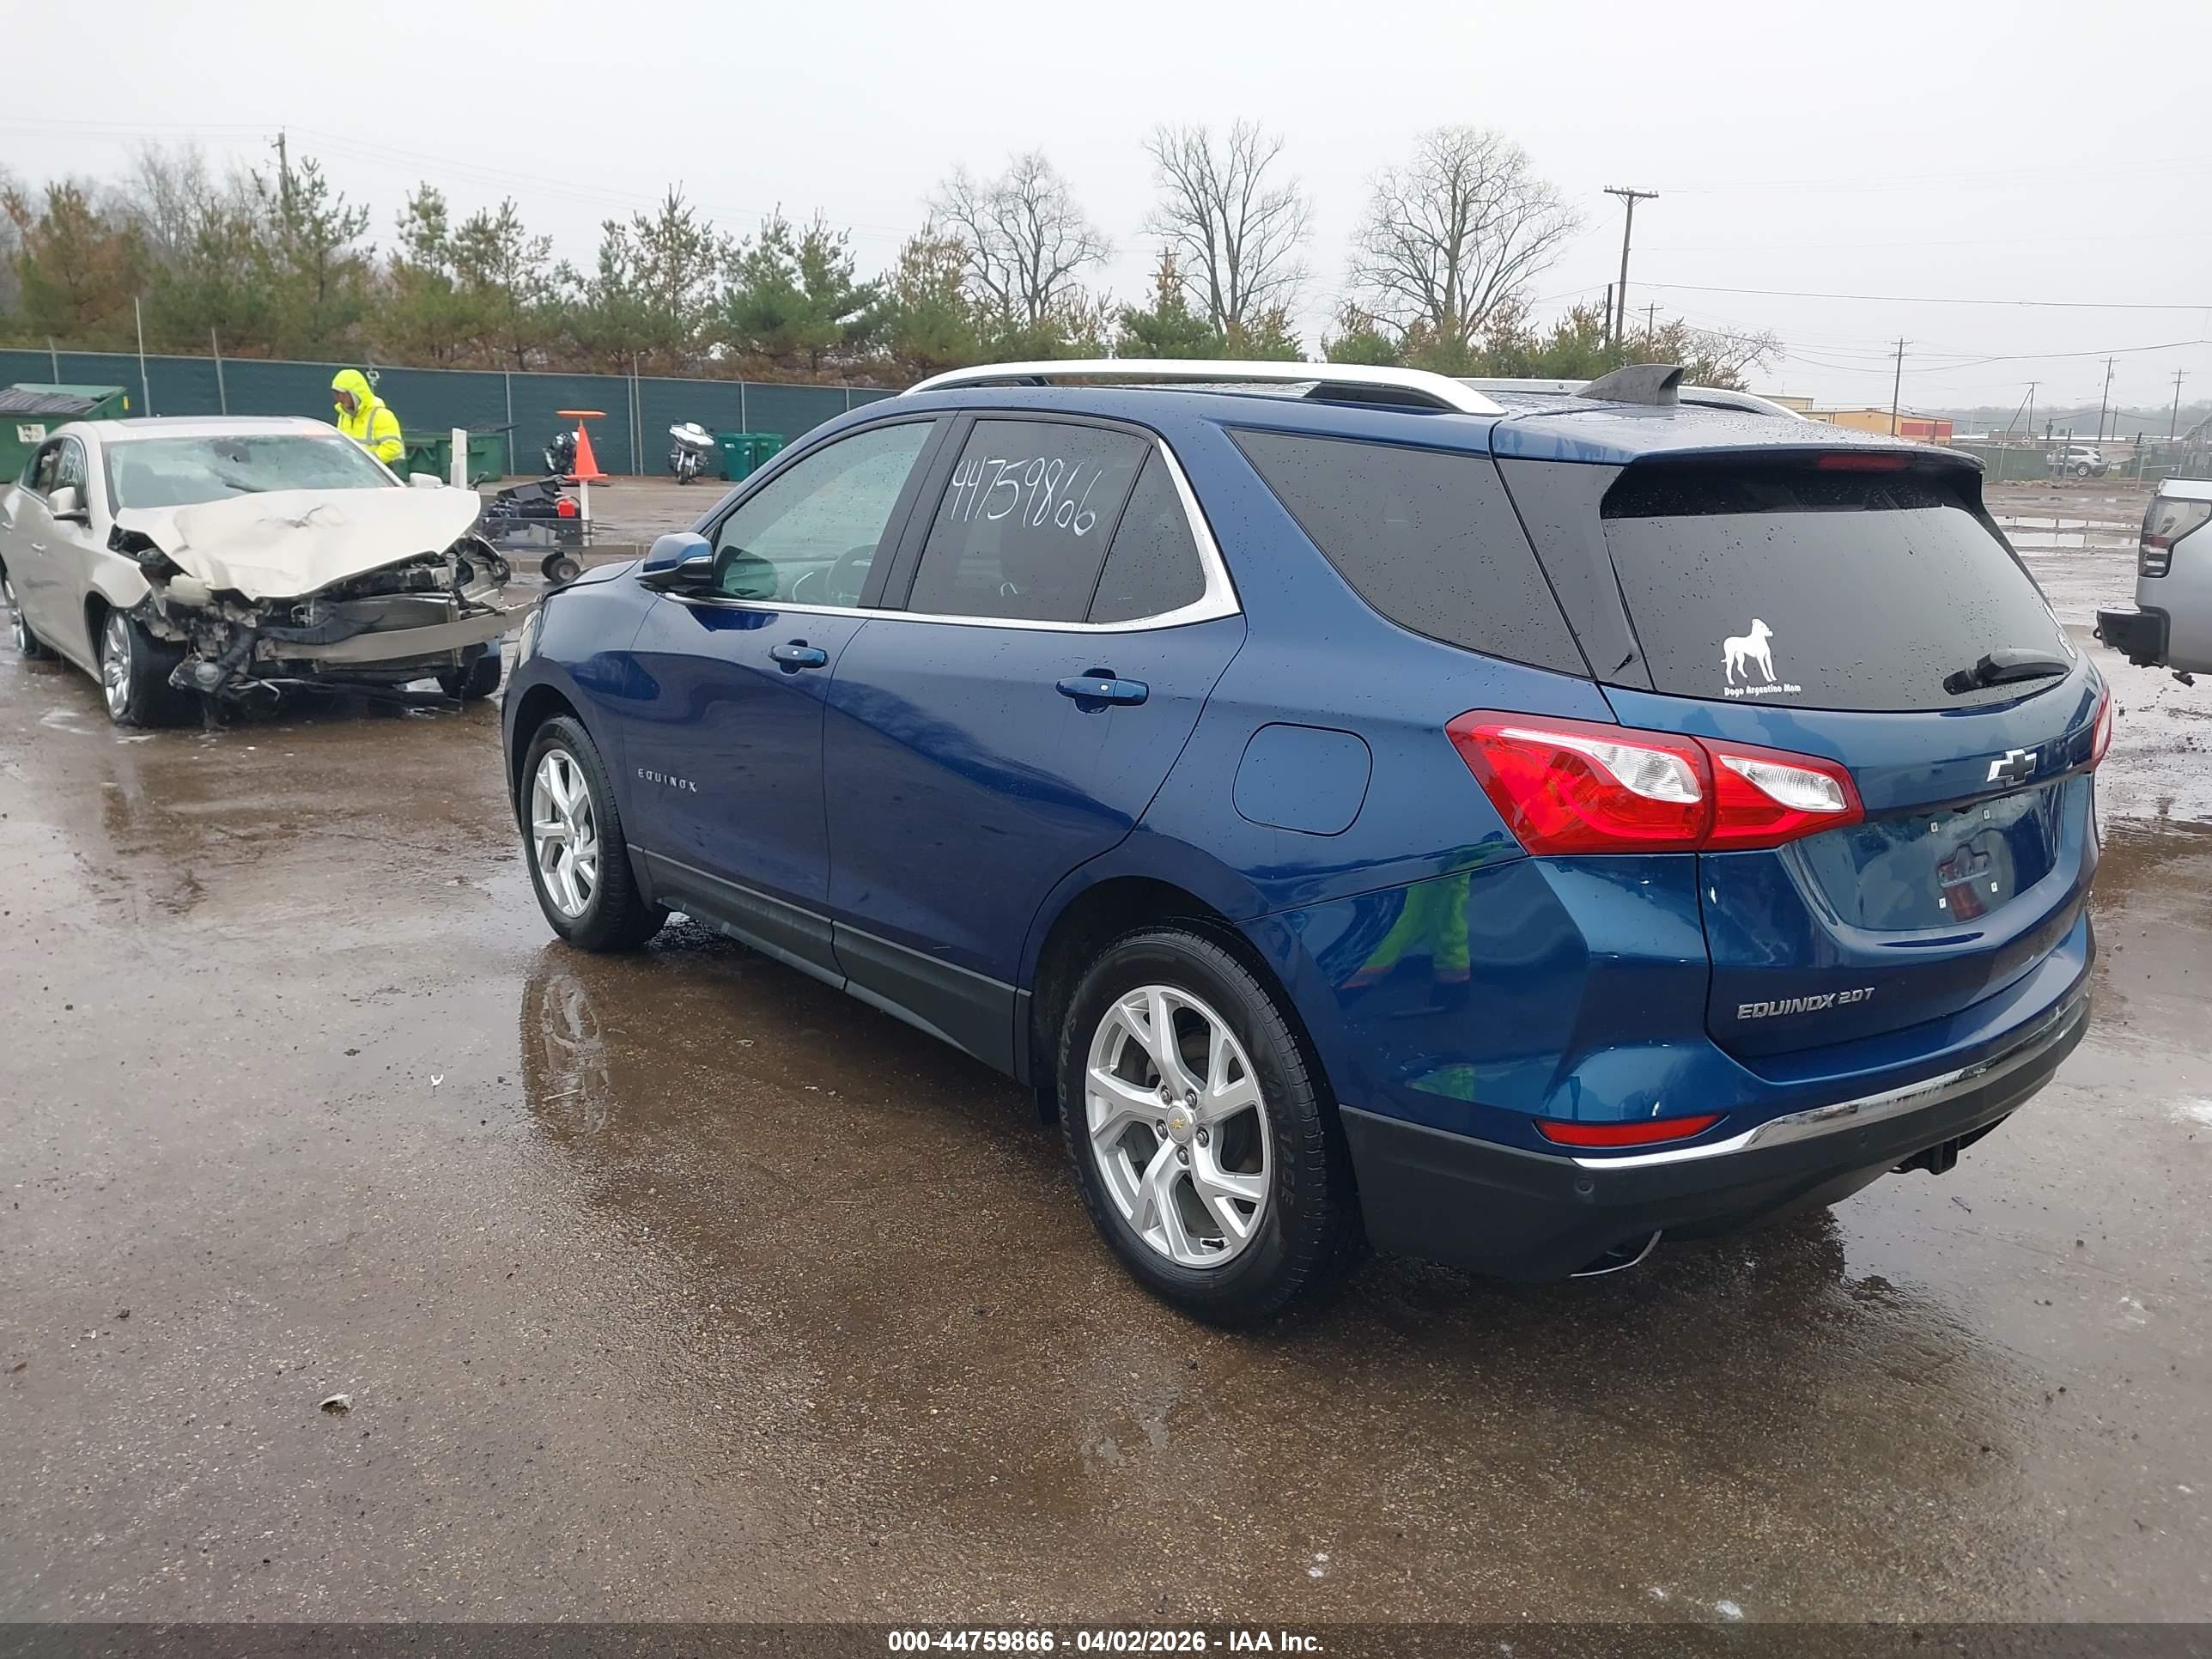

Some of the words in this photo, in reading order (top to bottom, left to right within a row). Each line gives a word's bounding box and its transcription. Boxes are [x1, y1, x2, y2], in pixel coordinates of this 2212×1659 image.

[951, 455, 1103, 537] 44759866
[1723, 687, 1745, 698] Dogo
[1746, 684, 1783, 696] Argentino
[637, 768, 697, 793] EQUINOX
[1737, 992, 1838, 1020] EQUINOX
